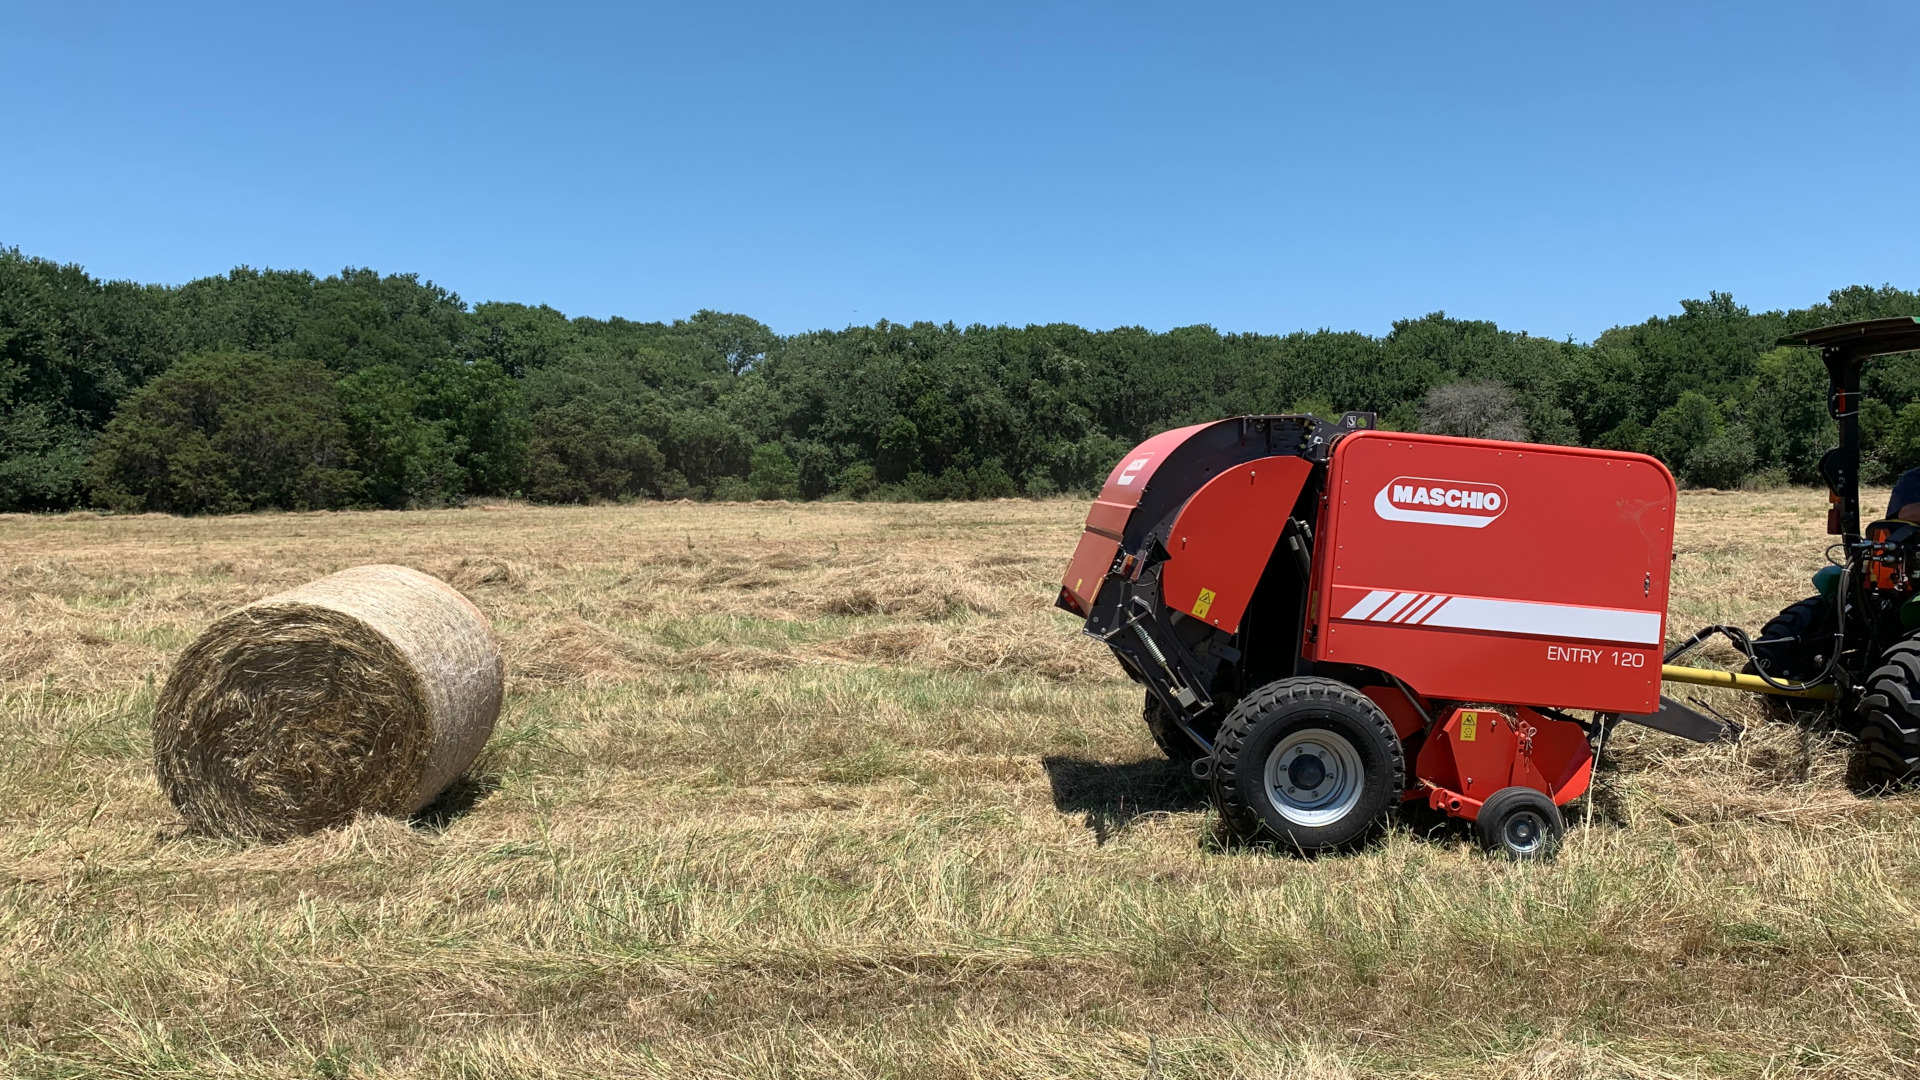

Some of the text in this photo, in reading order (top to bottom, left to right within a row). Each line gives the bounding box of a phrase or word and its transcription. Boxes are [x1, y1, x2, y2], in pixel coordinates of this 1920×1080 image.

[1393, 485, 1501, 511] MASCHIO
[1547, 645, 1645, 668] ENTRY 120
